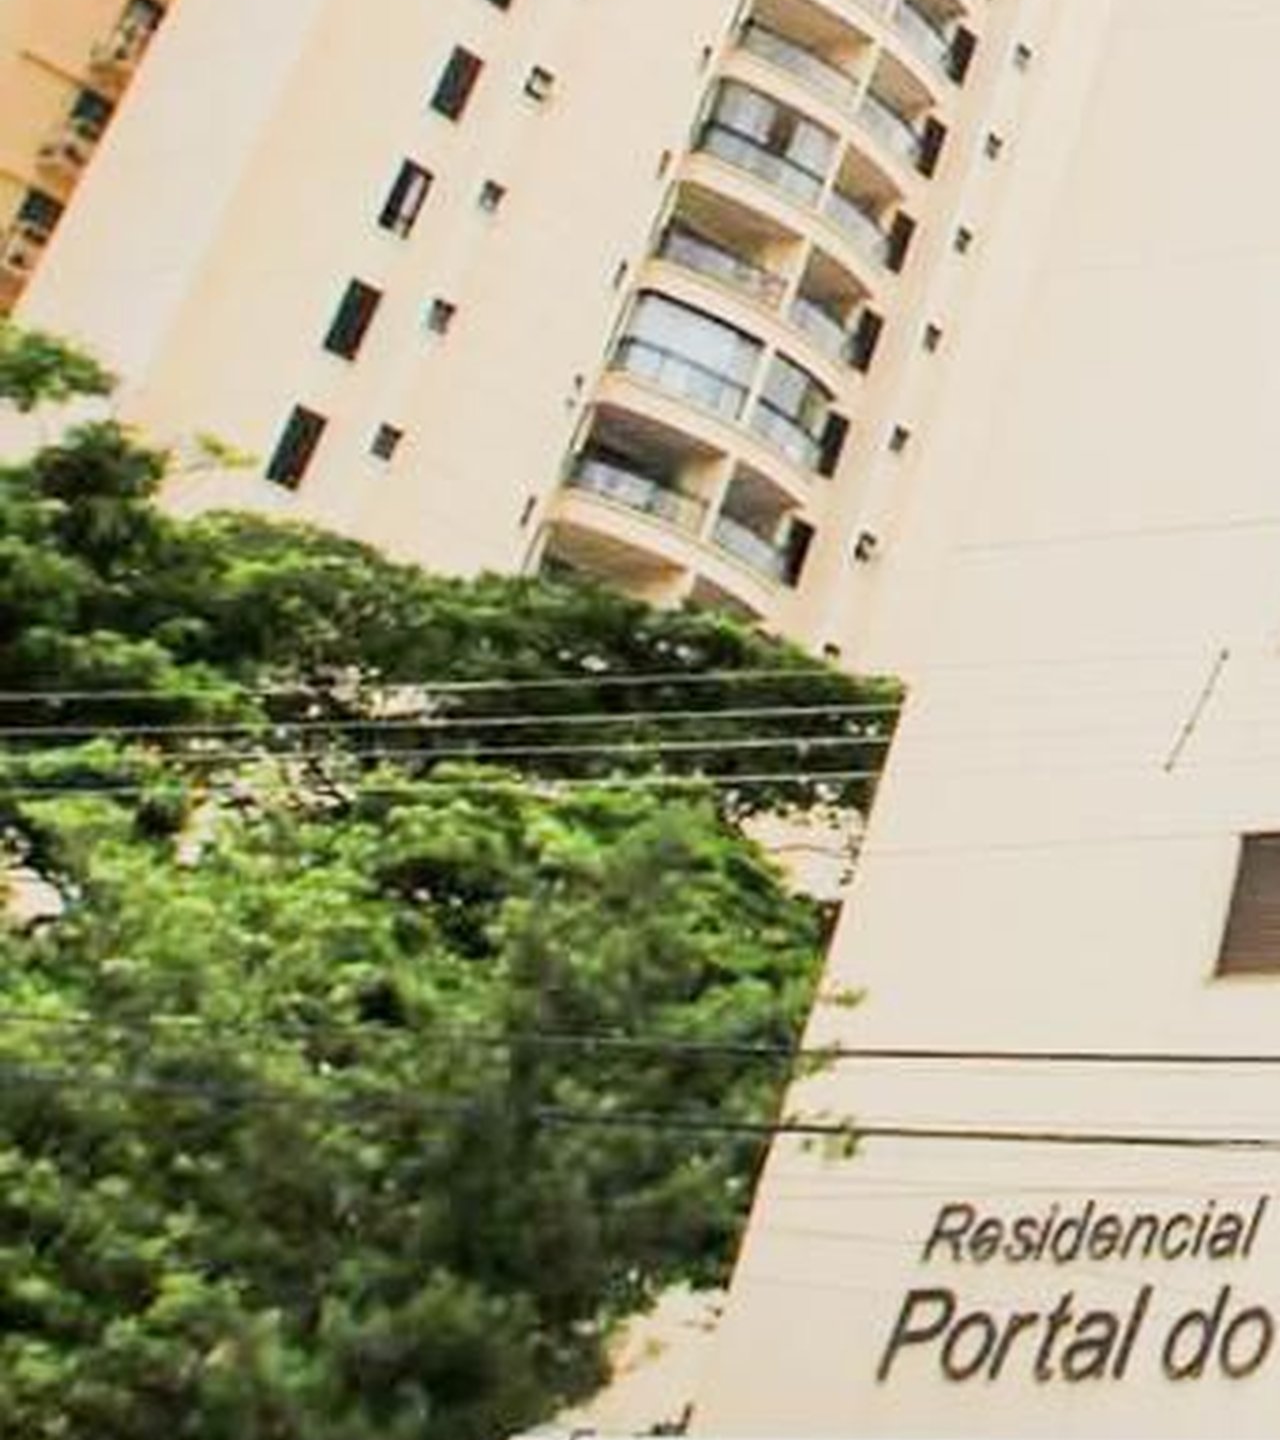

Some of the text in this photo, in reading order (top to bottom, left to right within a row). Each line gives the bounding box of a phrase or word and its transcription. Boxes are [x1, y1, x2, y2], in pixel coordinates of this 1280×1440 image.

[919, 1194, 1270, 1266] Residencial
[875, 1284, 1154, 1384] Portal
[1160, 1284, 1276, 1382] do
